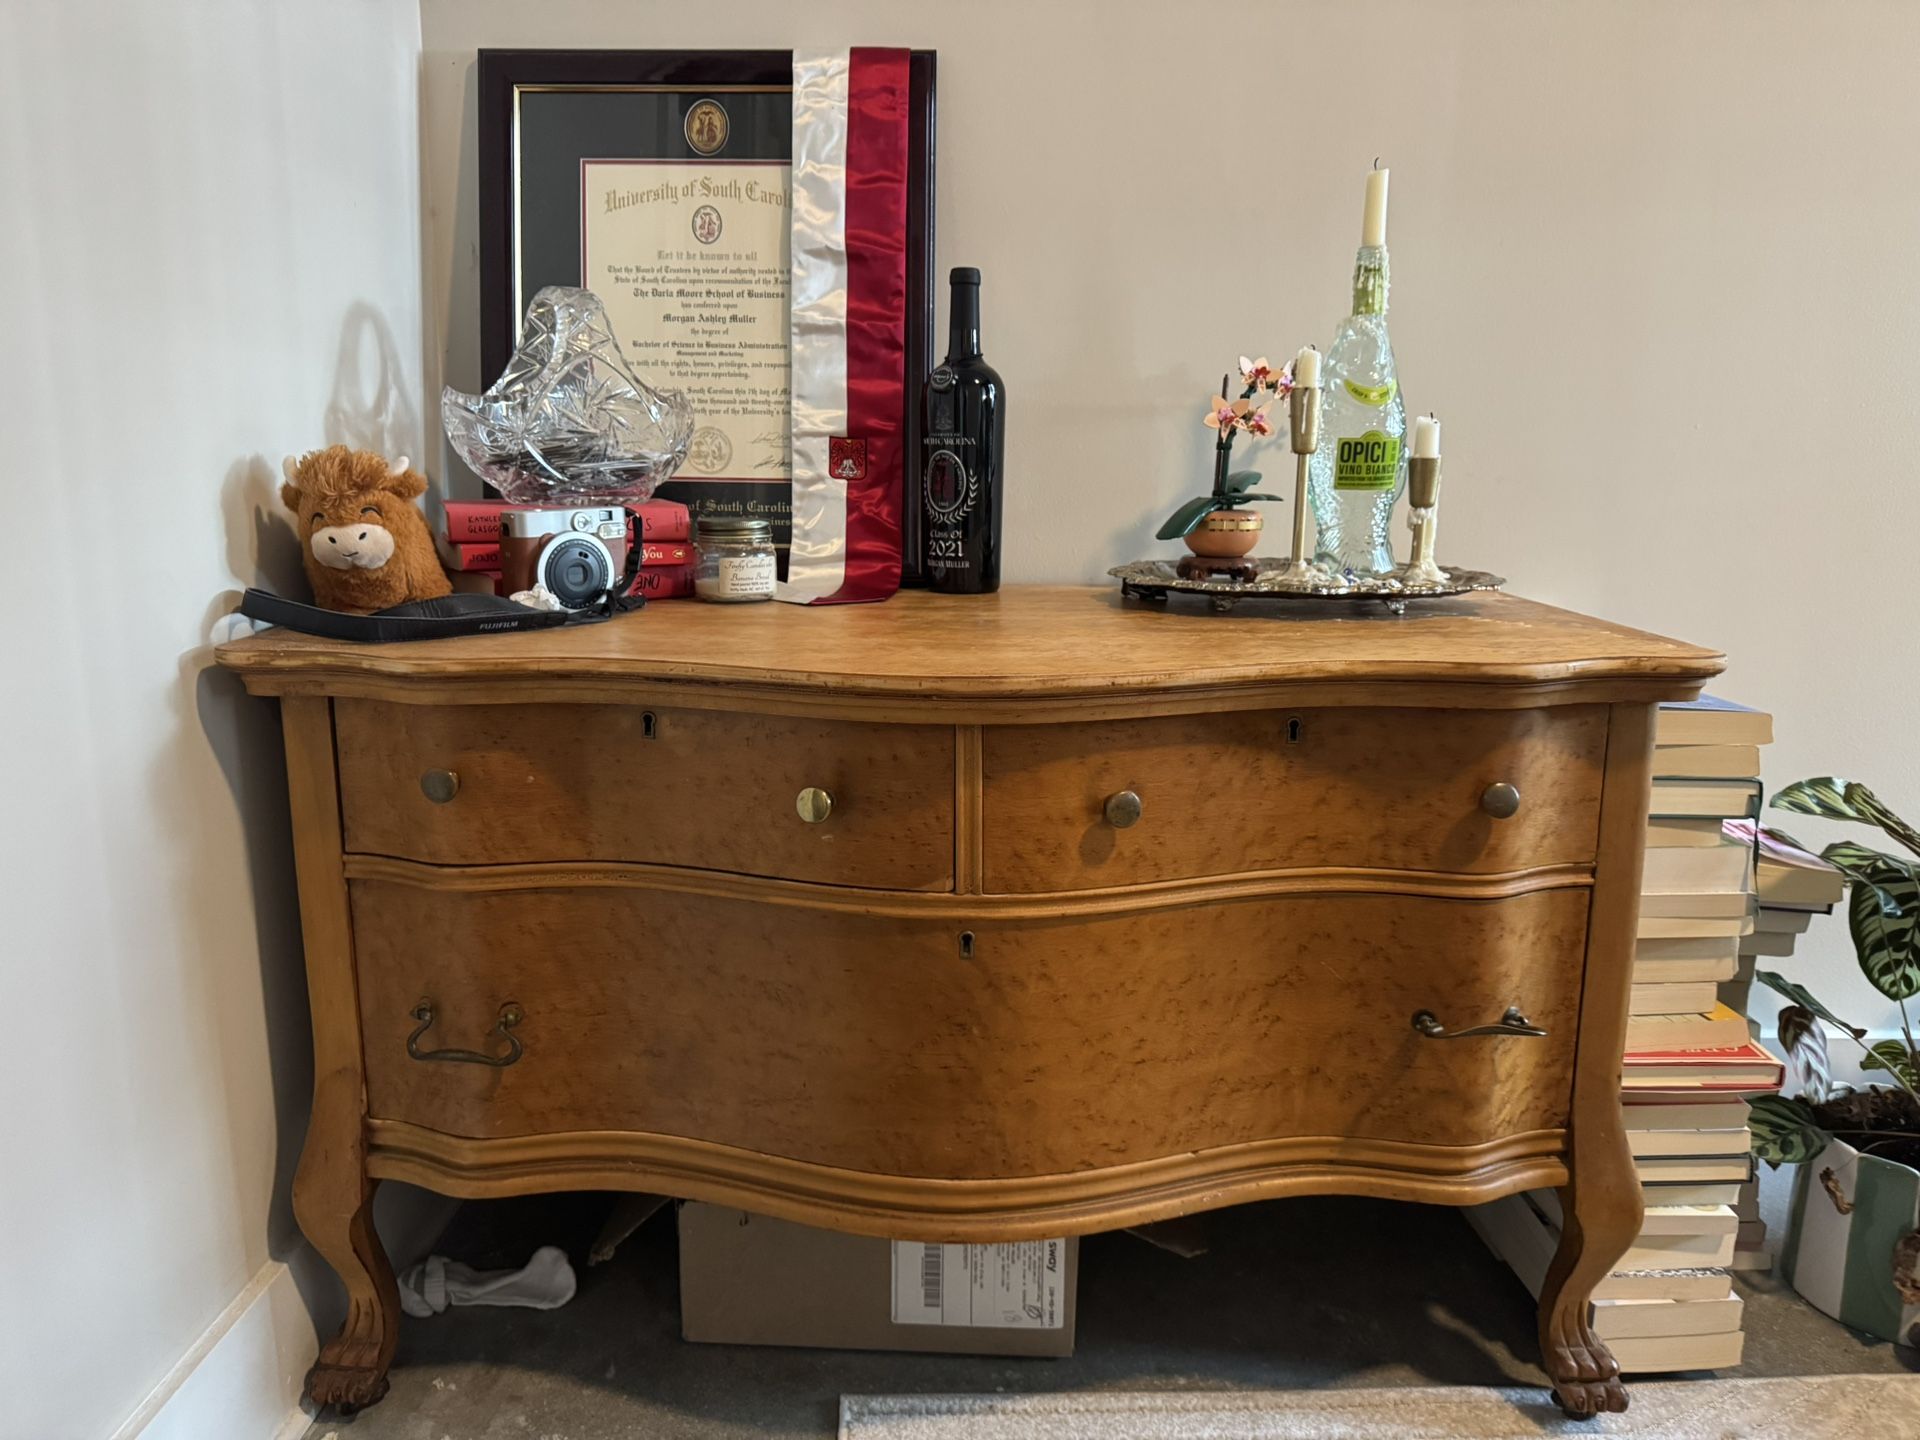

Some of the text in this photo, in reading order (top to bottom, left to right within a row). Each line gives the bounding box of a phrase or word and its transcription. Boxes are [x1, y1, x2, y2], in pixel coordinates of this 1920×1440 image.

[604, 175, 792, 215] University of South Caroli
[633, 288, 649, 299] The
[676, 288, 703, 299] Moore
[705, 288, 734, 299] School
[736, 288, 745, 299] of
[747, 288, 785, 299] Business
[662, 313, 757, 324] Morgan Ashley Muller
[1340, 441, 1387, 464] OPICI
[1338, 464, 1362, 475] VINO
[703, 499, 743, 515] South
[746, 500, 792, 513] Carolin
[467, 524, 500, 535] GLASGO
[929, 539, 964, 557] 2021
[468, 553, 499, 563] JOJO
[642, 546, 664, 562] You
[945, 559, 970, 569] MULLER
[479, 620, 519, 630] FUJIFILM
